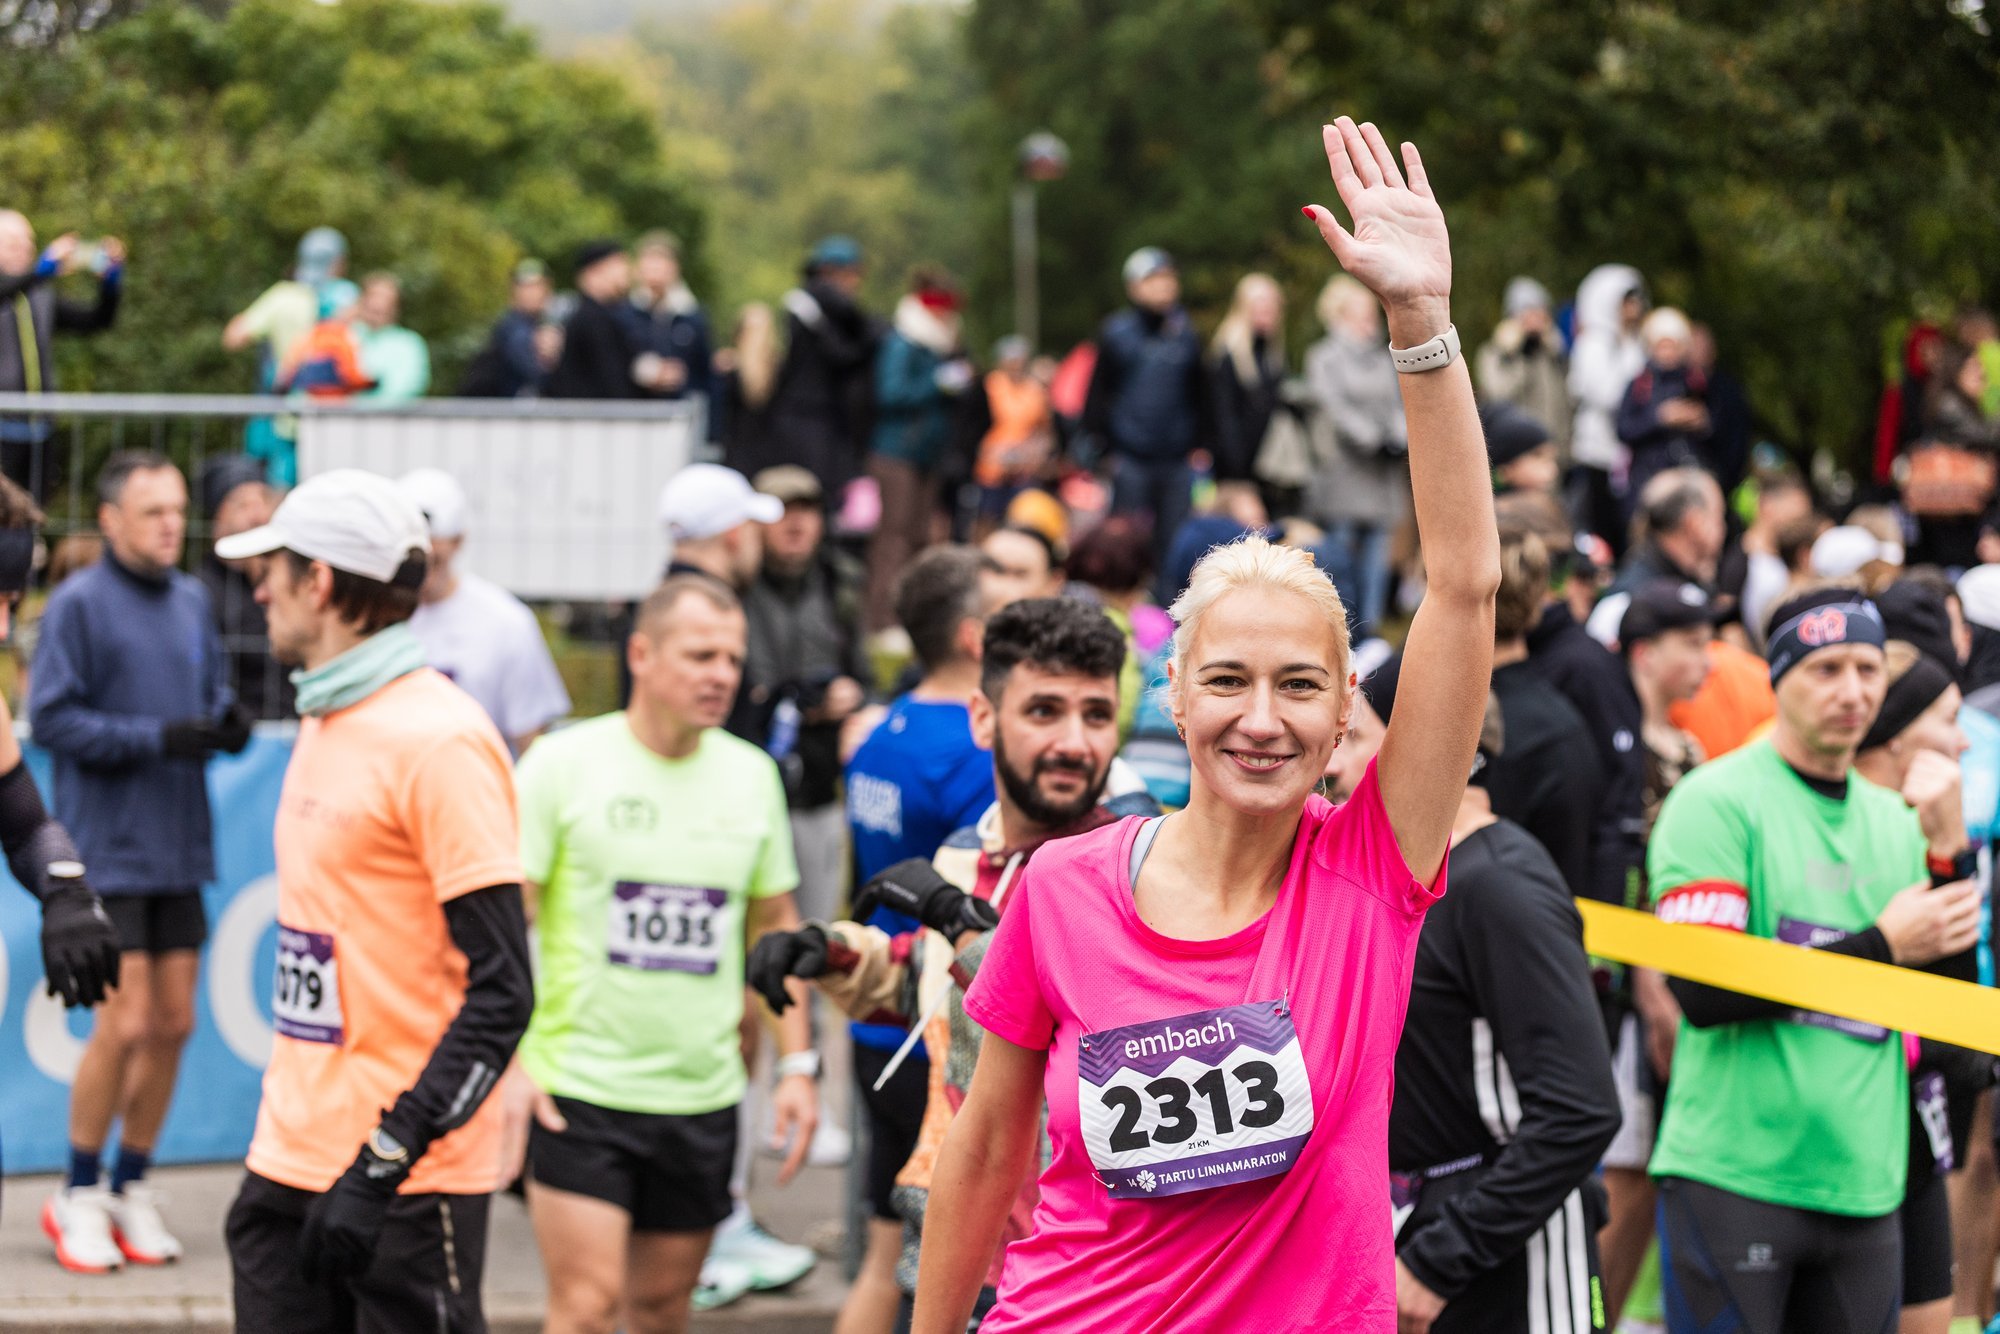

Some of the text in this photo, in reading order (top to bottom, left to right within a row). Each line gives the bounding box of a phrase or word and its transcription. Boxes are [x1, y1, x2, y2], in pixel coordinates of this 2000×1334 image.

[627, 912, 715, 947] 1035
[1125, 1017, 1236, 1059] embach
[1101, 1060, 1285, 1154] 2313
[1198, 1140, 1210, 1148] KM
[1159, 1168, 1195, 1185] TARTU
[1197, 1151, 1287, 1178] LINNAMARATON
